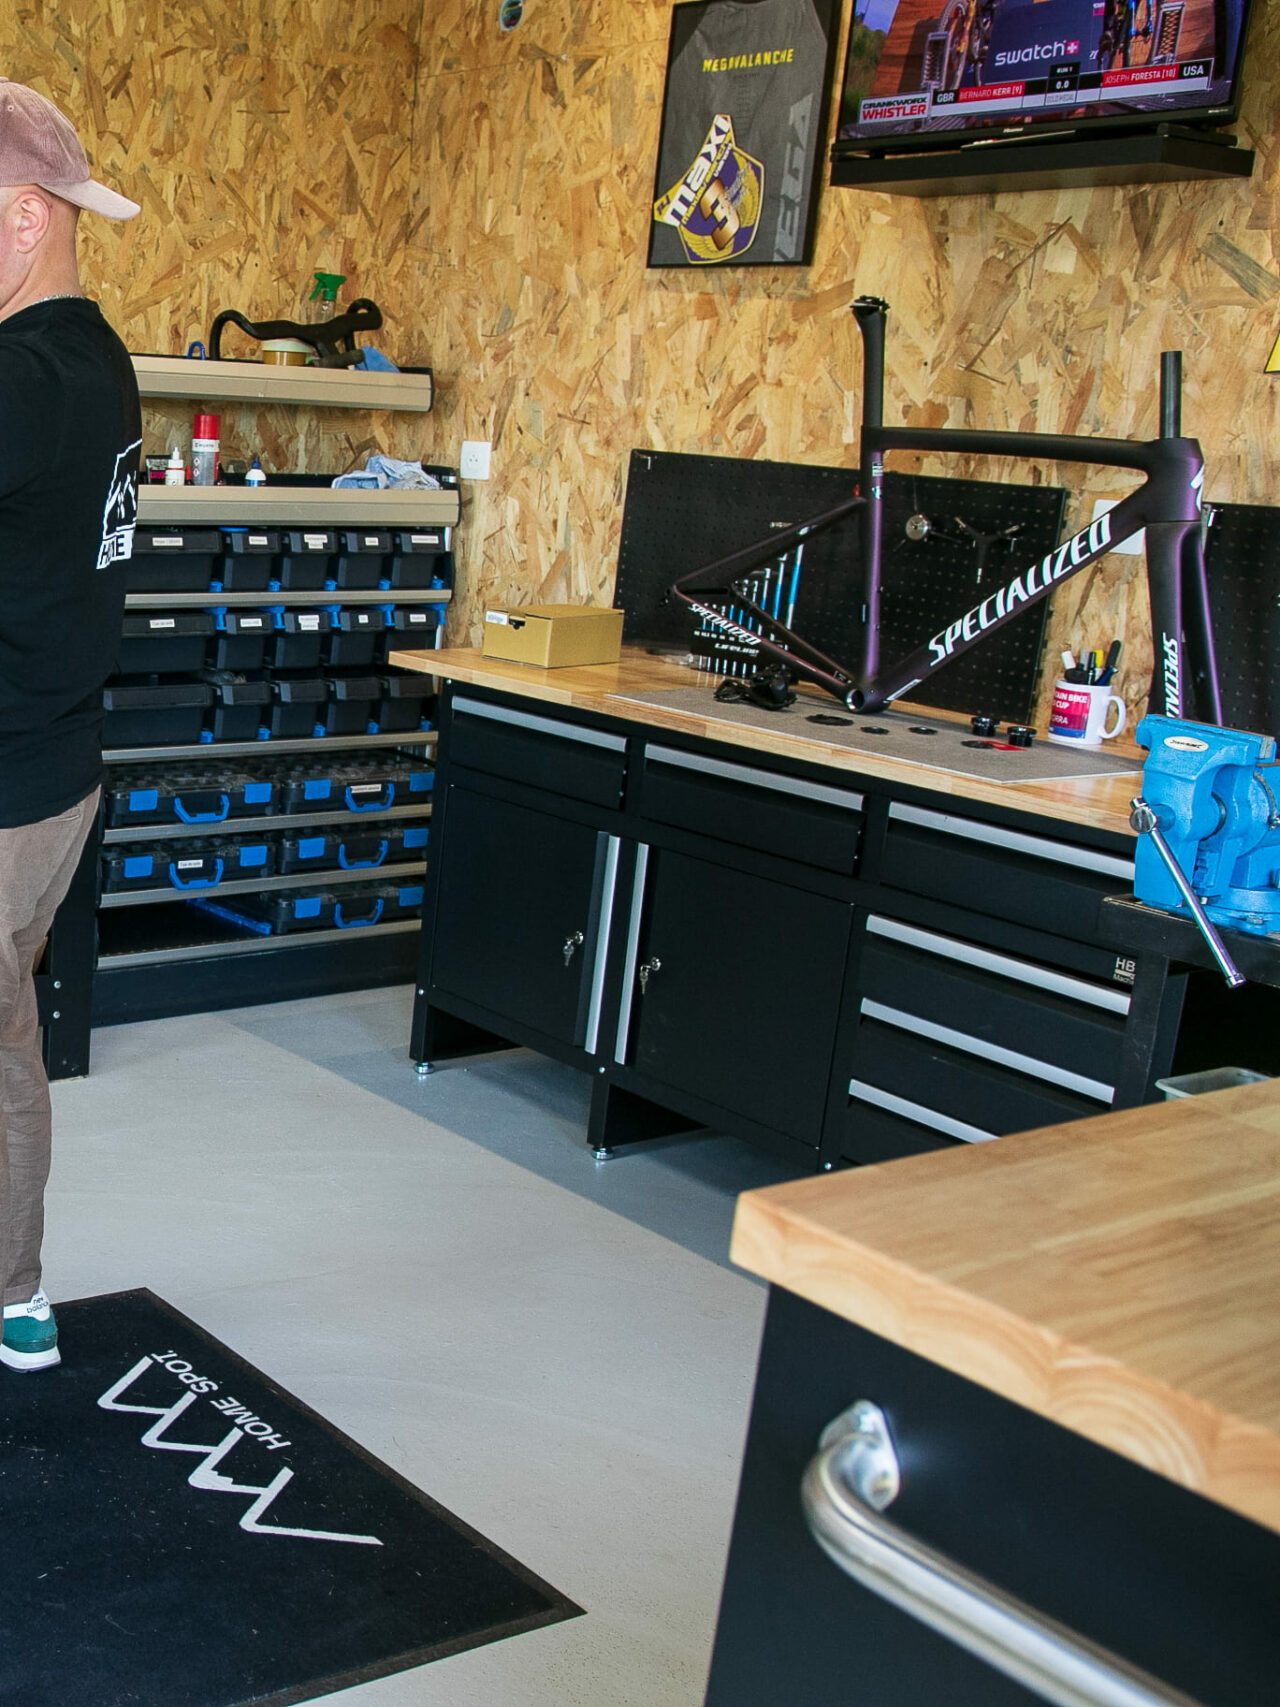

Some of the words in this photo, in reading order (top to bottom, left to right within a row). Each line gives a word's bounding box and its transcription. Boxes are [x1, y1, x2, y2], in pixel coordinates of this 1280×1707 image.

[702, 48, 794, 73] MEGAVALANCHE
[994, 41, 1065, 66] swatch
[1105, 73, 1129, 84] JOSEPH
[1130, 70, 1161, 81] FORESTA
[1183, 64, 1204, 77] USA
[1055, 80, 1069, 90] 0.0
[936, 91, 955, 104] GBR
[959, 88, 992, 101] BERNARD
[992, 87, 1011, 96] KERR
[862, 97, 928, 110] CRANKWORX
[862, 103, 927, 121] WHISTLER
[928, 513, 1111, 667] SPECIALIZED
[691, 602, 762, 646] SPECIALIZED
[1116, 956, 1136, 972] HB
[209, 1396, 292, 1450] HOME
